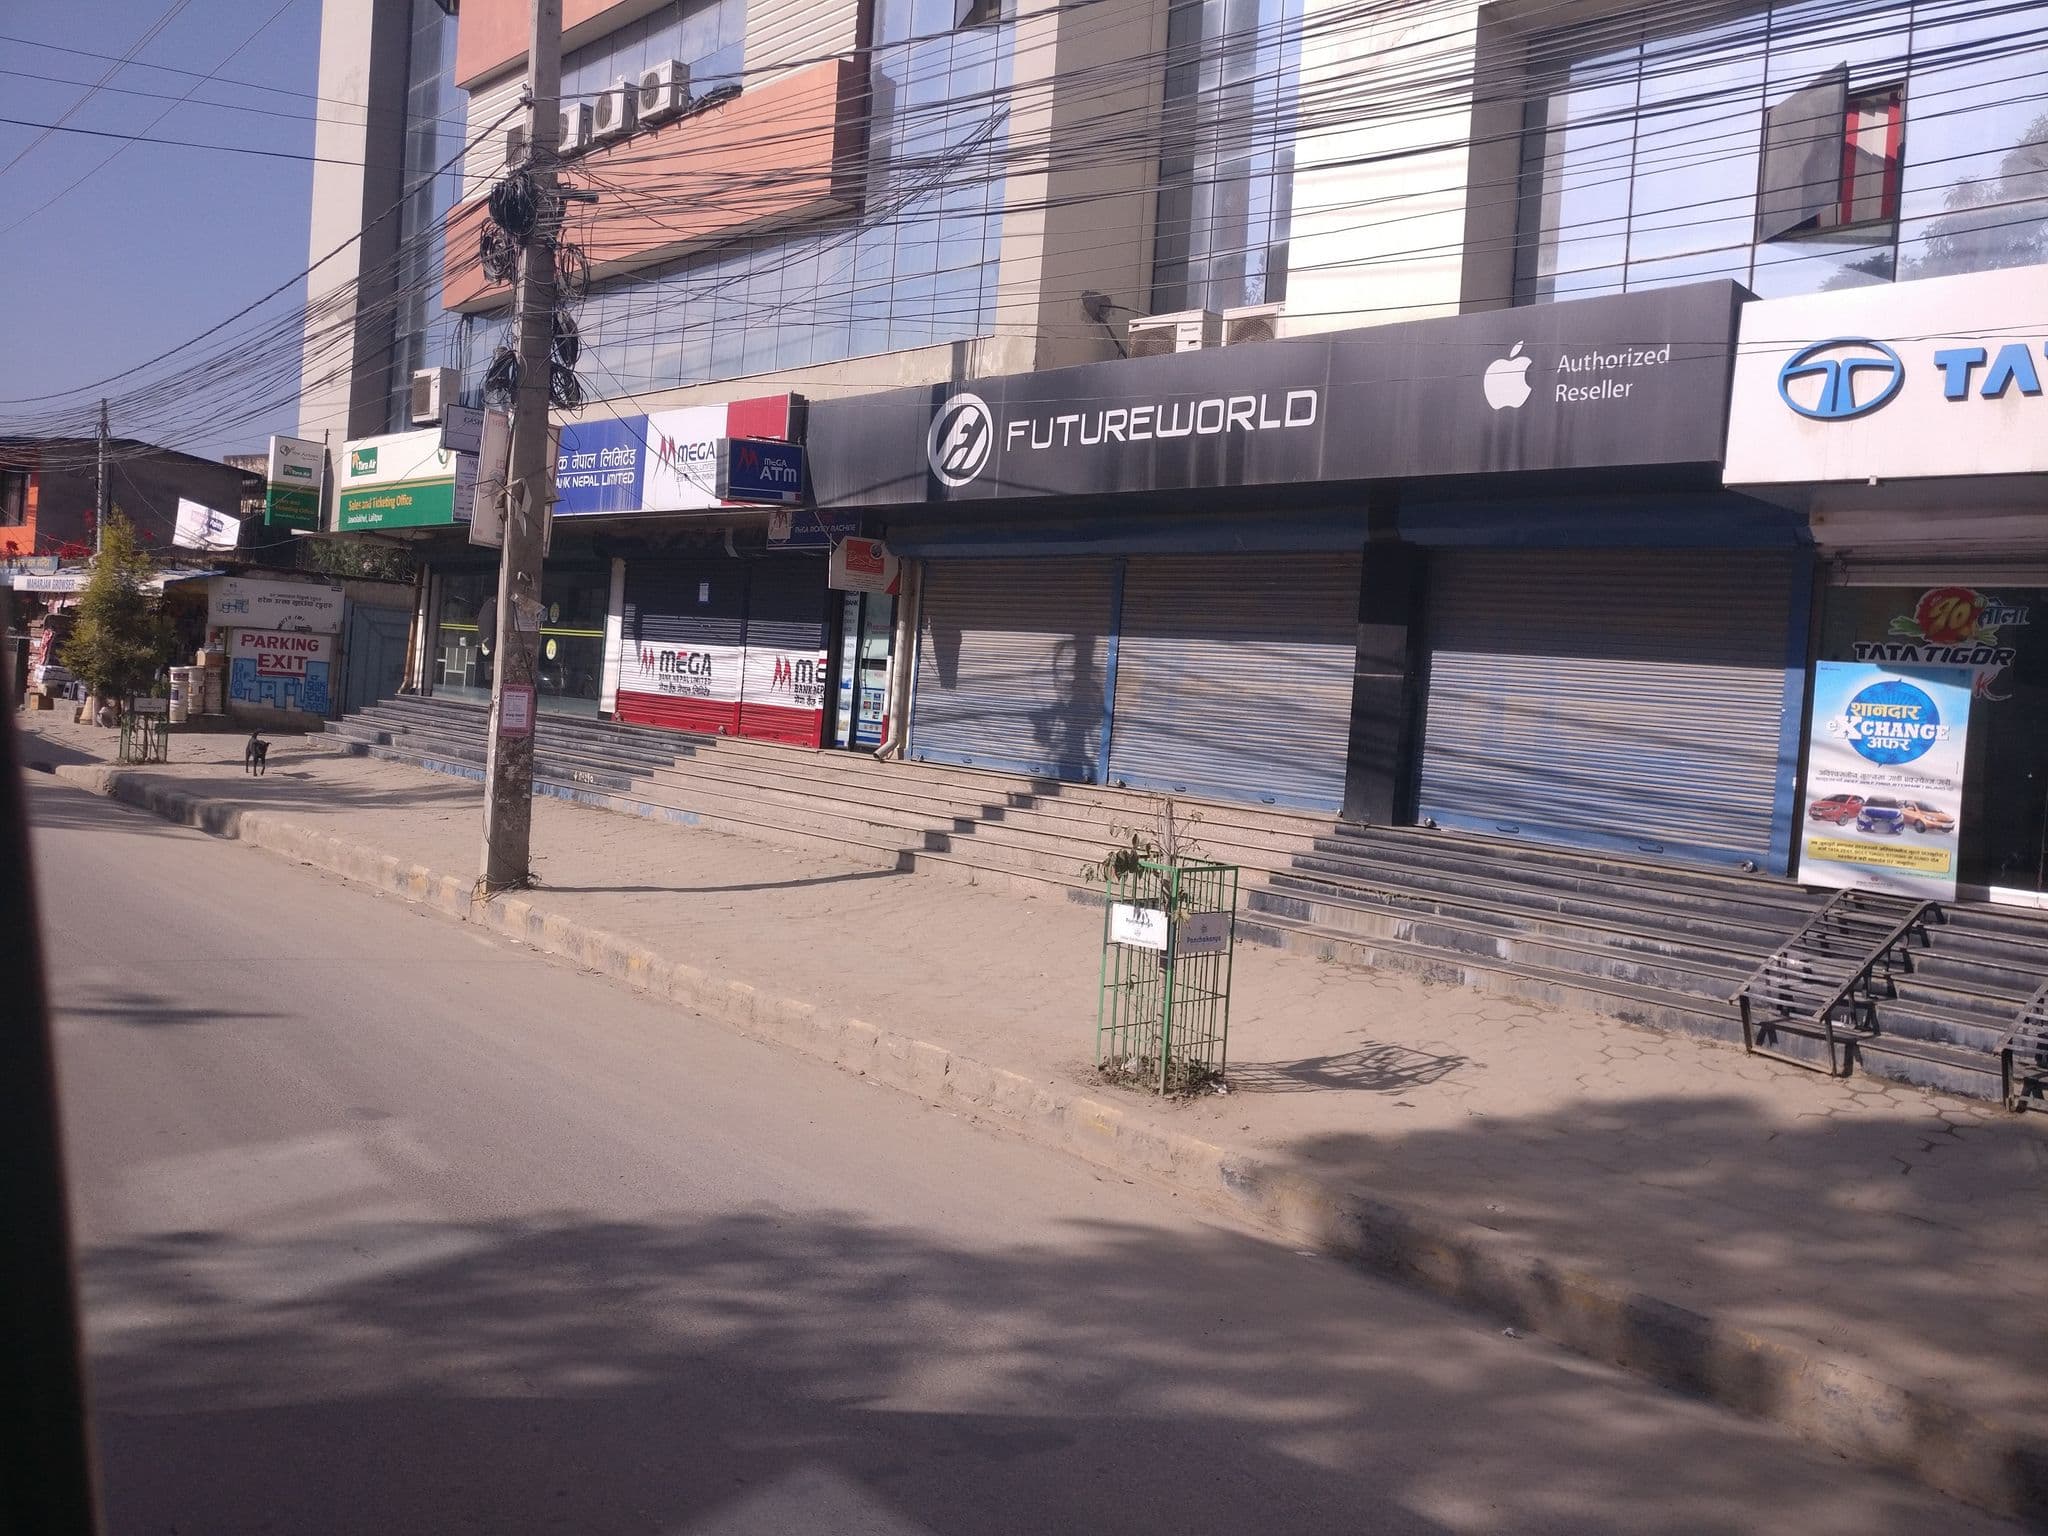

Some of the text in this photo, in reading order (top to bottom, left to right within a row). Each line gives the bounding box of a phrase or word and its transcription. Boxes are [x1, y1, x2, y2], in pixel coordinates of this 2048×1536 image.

[1556, 343, 1670, 373] Authorized
[1933, 341, 2048, 402] TA
[1555, 380, 1633, 402] Reseller
[1006, 389, 1318, 452] FUTUREWORLD
[571, 451, 597, 470] नेपाल
[677, 441, 715, 463] MEGA
[572, 474, 600, 488] NEPAL
[601, 472, 635, 487] LIMITED
[759, 465, 797, 483] ATM
[241, 634, 320, 652] PARKING
[257, 653, 308, 671] EXIT
[659, 650, 712, 677] MEGA
[1856, 643, 2015, 666] TATA TIGOR
[1850, 702, 1922, 721] शानदार
[1866, 737, 1912, 751] अफर
